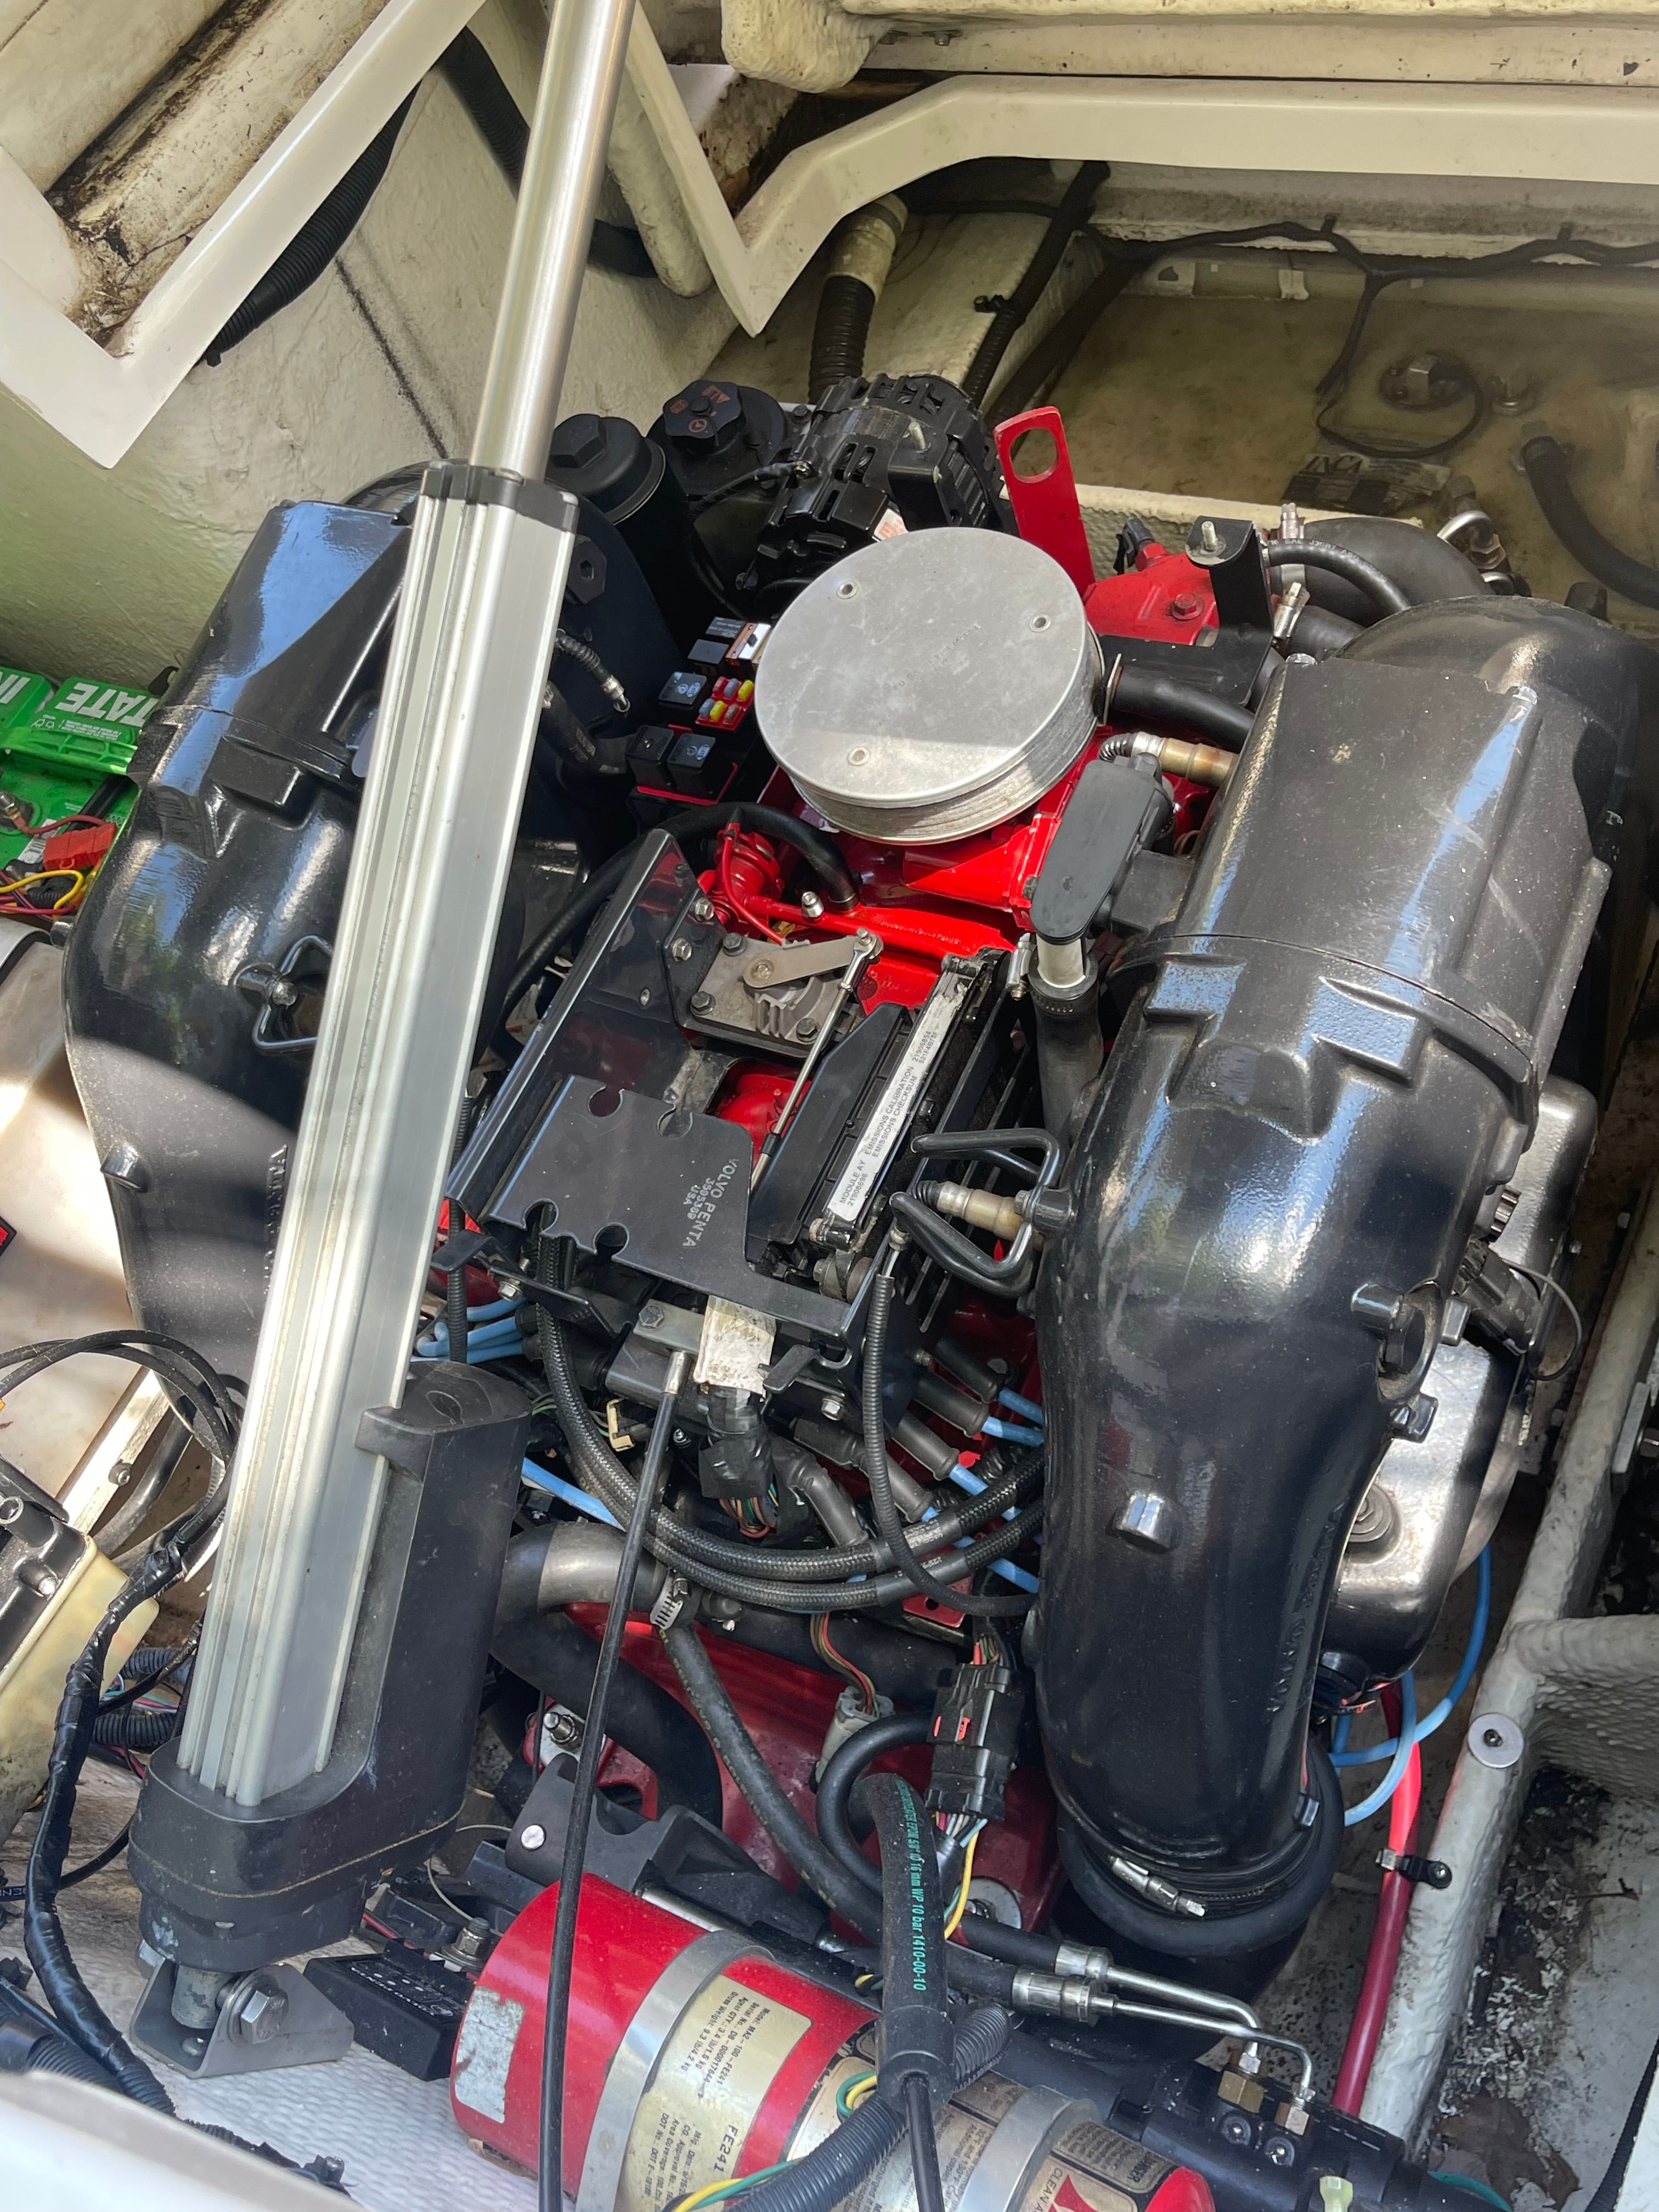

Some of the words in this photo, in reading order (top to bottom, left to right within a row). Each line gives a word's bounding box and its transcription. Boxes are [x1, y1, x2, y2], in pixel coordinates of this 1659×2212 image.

[864, 1114, 889, 1155] EMISSIONS
[885, 1065, 914, 1114] CALIBRATION
[872, 1116, 896, 1158] EMISSIONS
[892, 1075, 918, 1116] CHECKSUM
[710, 1159, 739, 1198] VOLVO
[839, 1171, 859, 1204] MODULE
[856, 1160, 866, 1171] AY
[682, 1185, 700, 1204] USA
[682, 1203, 715, 1246] PENTA
[910, 1863, 922, 1871] 16
[911, 1888, 924, 1902] WP
[911, 1904, 924, 1915] 10
[912, 1916, 924, 1932] bar
[912, 1935, 926, 1990] 1410-00-10
[723, 1990, 738, 2006] Gross
[733, 1996, 748, 2011] Agent
[743, 2002, 759, 2017] Serial
[681, 2062, 691, 2071] kg
[696, 2060, 706, 2069] kg
[659, 2112, 668, 2129] DOT
[668, 2118, 680, 2136] Area
[714, 2124, 738, 2173] FE241
[953, 2123, 977, 2158] Additional
[649, 2147, 658, 2163] DOT
[672, 2139, 685, 2172] Approval
[964, 2144, 977, 2159] and
[1040, 2168, 1063, 2203] CLEAN
